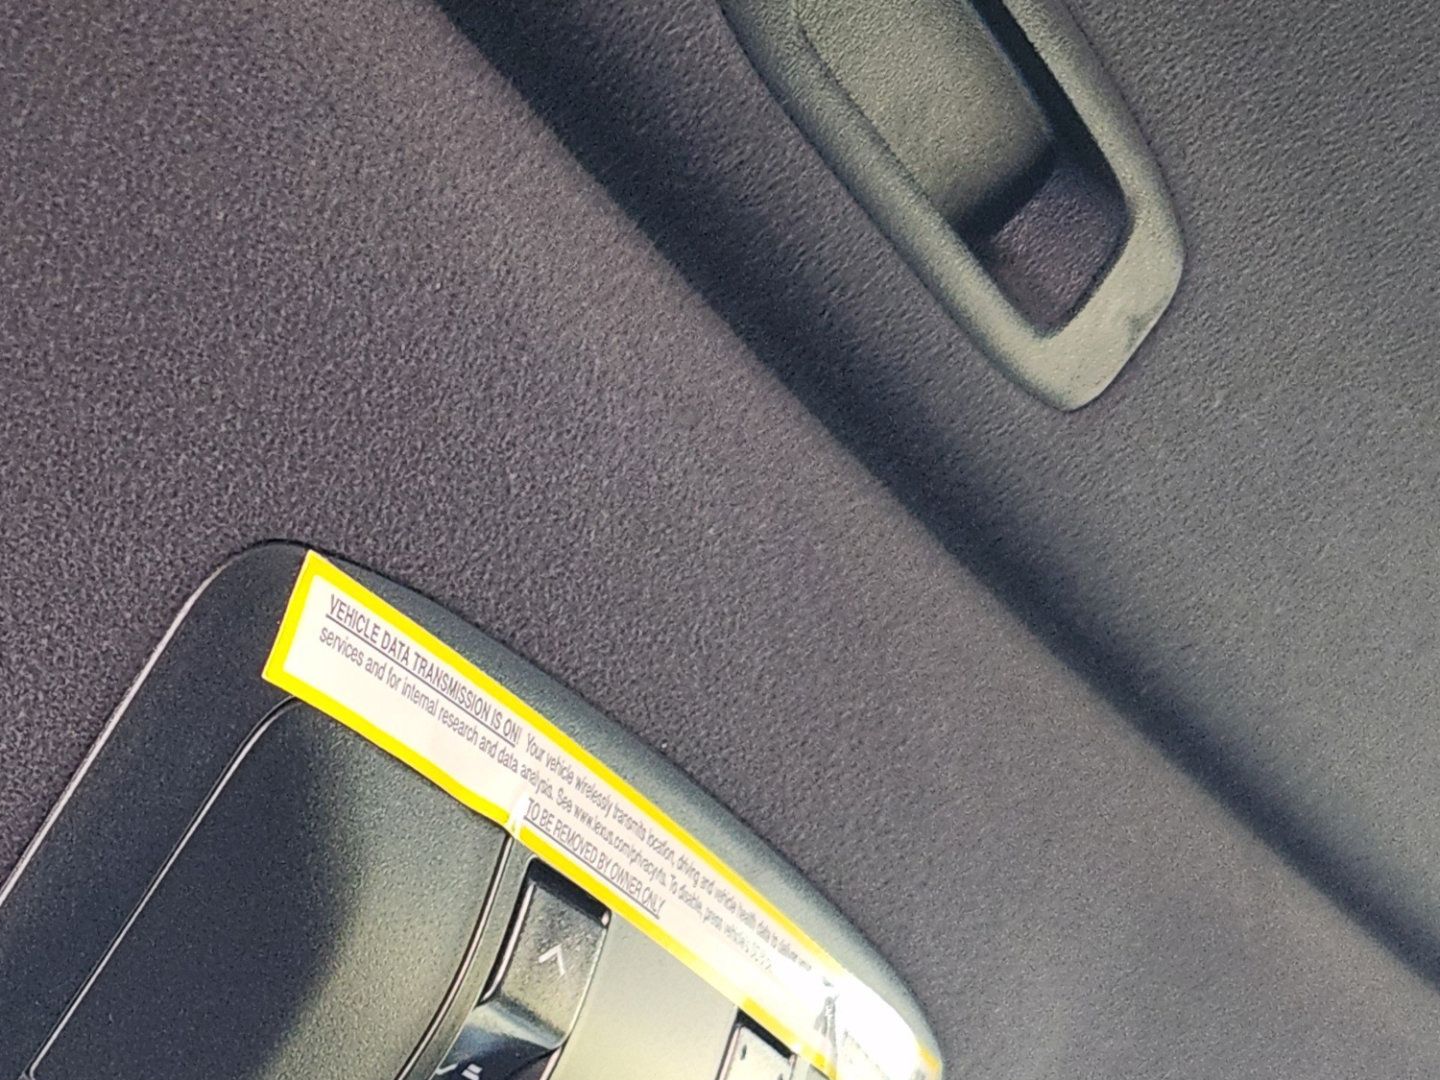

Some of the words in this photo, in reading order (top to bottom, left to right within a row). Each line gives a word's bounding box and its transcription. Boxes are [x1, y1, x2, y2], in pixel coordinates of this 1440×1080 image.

[319, 626, 365, 667] services
[365, 656, 387, 681] and
[386, 665, 402, 691] for
[401, 677, 439, 717] internal
[438, 706, 478, 746] research
[479, 734, 499, 759] and
[497, 744, 518, 774] data
[330, 593, 381, 644] VEHICLE
[381, 629, 410, 667] DATA
[412, 652, 492, 722] TRANSMISSION
[490, 708, 503, 731] IS
[526, 733, 546, 762] Your
[545, 752, 575, 786] vehicle
[525, 797, 540, 821] TO
[539, 808, 555, 833] BE
[553, 818, 599, 865] REMOVED
[597, 851, 612, 875] BY
[610, 862, 642, 896] OWNER
[641, 886, 667, 915] ONLY
